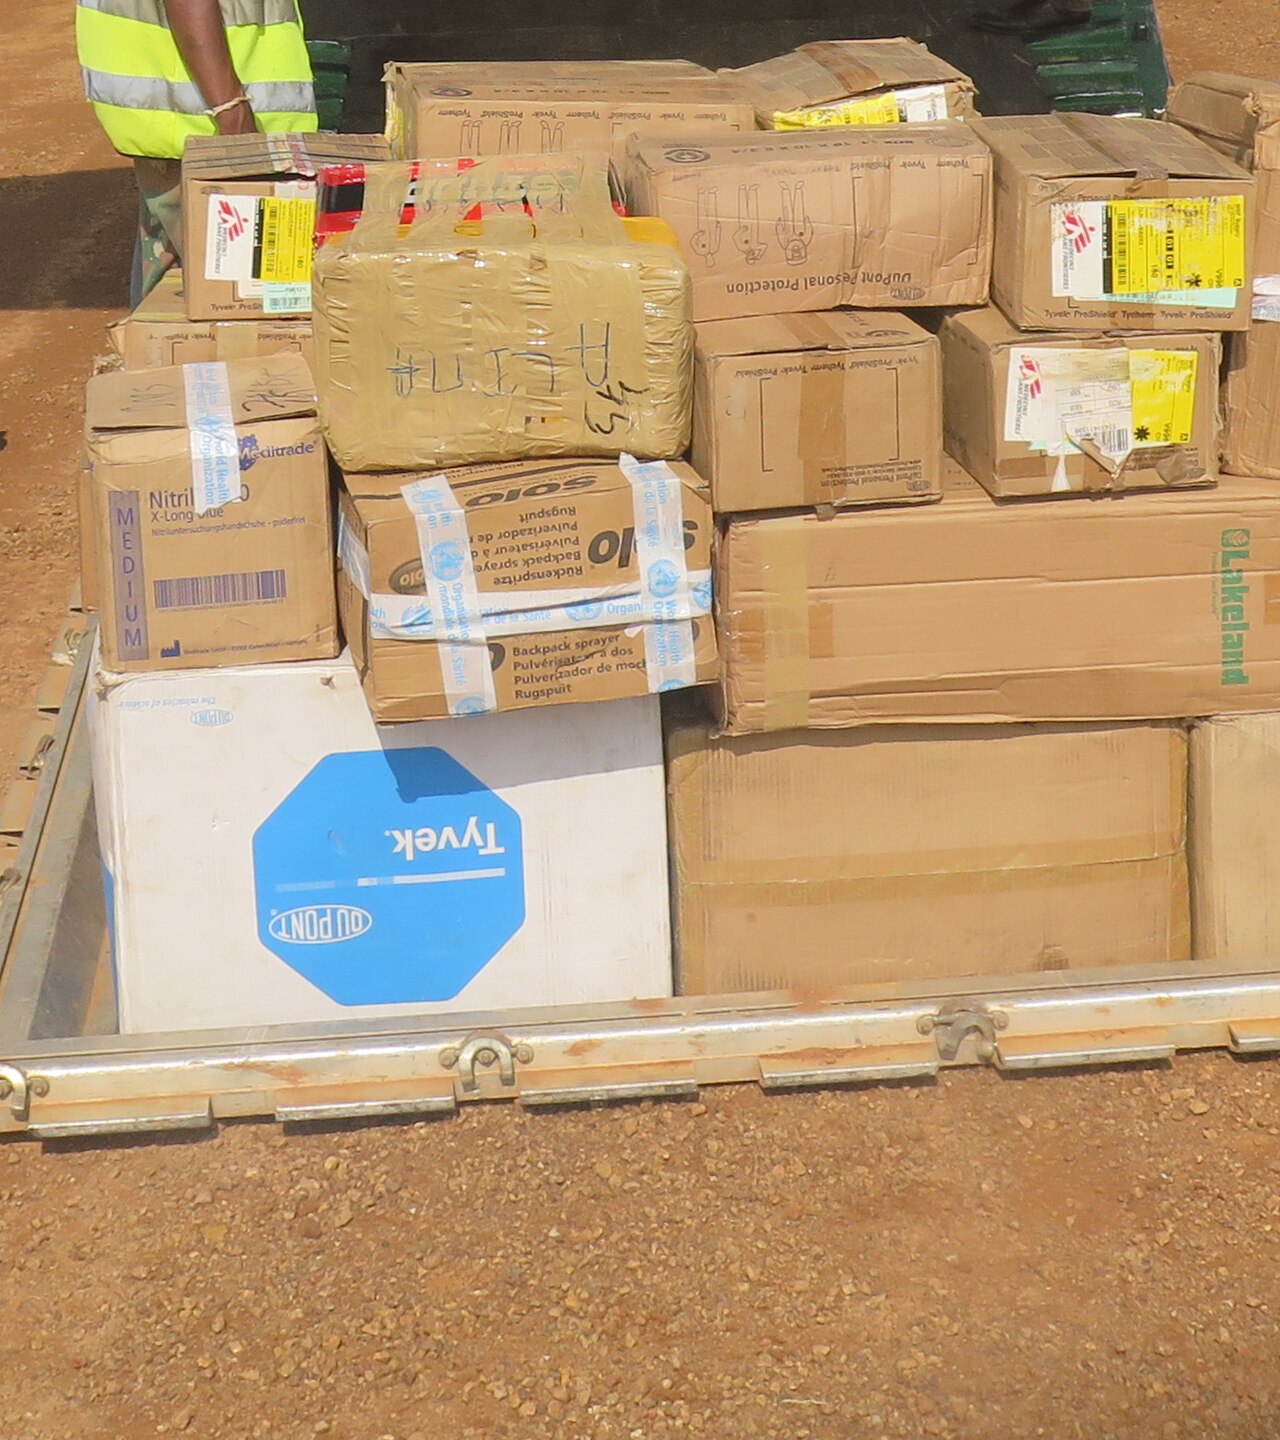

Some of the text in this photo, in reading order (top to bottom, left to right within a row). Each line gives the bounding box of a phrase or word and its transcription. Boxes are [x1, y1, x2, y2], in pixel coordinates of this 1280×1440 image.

[726, 277, 799, 295] Protection
[803, 273, 858, 292] Pesonal
[238, 440, 318, 461] Meditrade
[464, 475, 598, 507] solo
[150, 510, 193, 523] X-Long
[519, 506, 576, 523] Rugspuit
[478, 521, 578, 544] Pulverizador de
[493, 536, 579, 556] Pulvérisateur
[587, 519, 699, 569] slo
[475, 550, 582, 574] Backpack spraye
[116, 507, 142, 647] MEDIUM
[493, 565, 583, 586] Rückenspritze
[1221, 550, 1250, 686] Lakeland
[512, 634, 620, 658] Backpack sprayer
[611, 647, 633, 657] dos
[597, 661, 612, 673] de
[515, 683, 572, 701] Rugspuit
